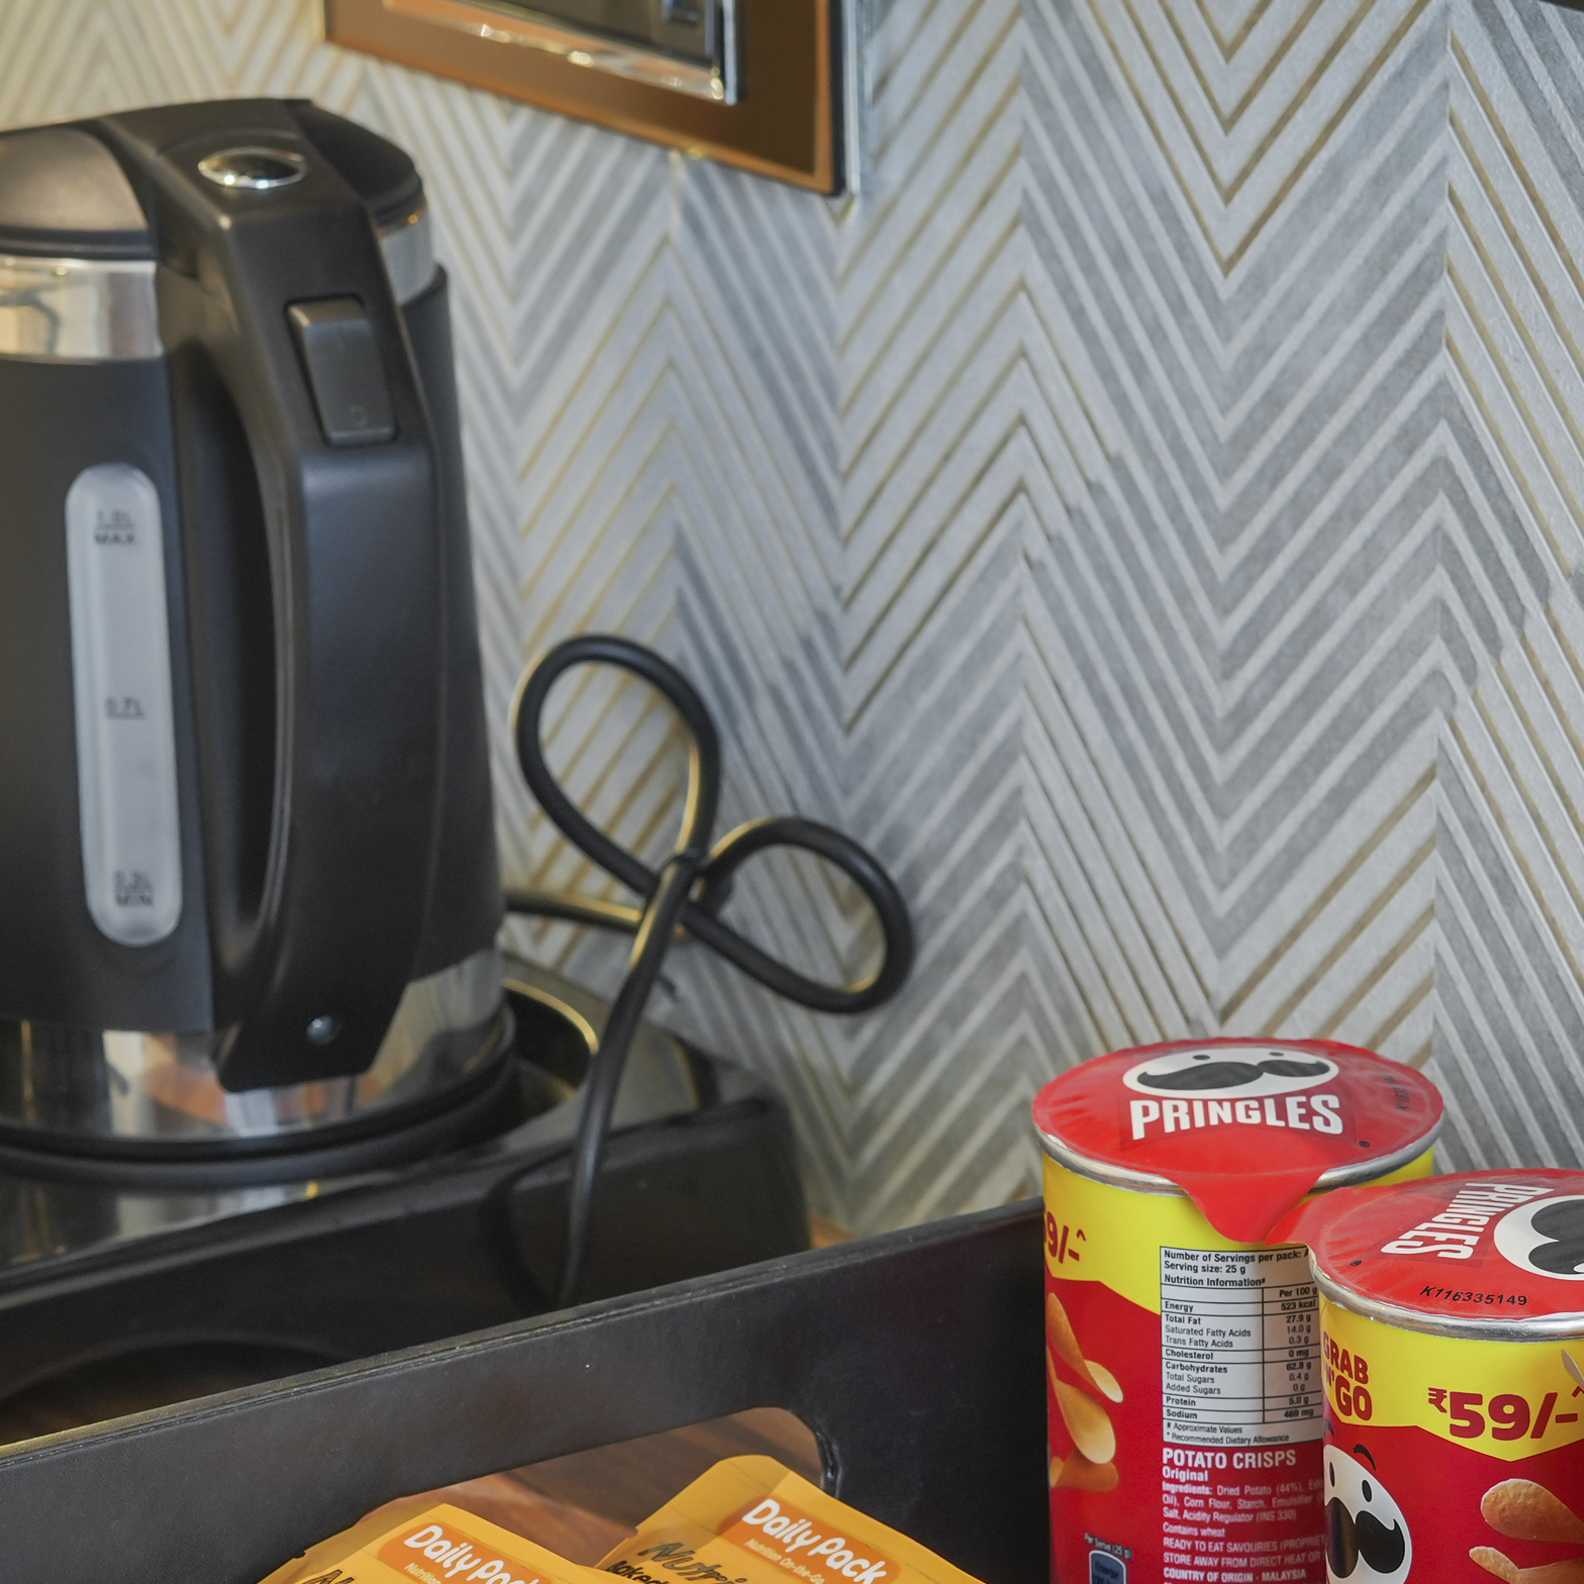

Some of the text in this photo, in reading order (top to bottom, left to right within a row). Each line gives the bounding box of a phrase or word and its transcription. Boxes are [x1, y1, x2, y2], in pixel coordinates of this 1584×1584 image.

[1129, 1094, 1344, 1140] PRINGLES
[1380, 1182, 1554, 1260] PRINGLES
[1164, 1250, 1199, 1262] Number
[1202, 1253, 1212, 1262] of
[1213, 1253, 1256, 1264] Servings
[1258, 1253, 1273, 1264] per
[1276, 1251, 1302, 1263] pack:
[1164, 1261, 1246, 1275] Serving size: 25 g
[1164, 1274, 1204, 1286] Nutrition
[1279, 1287, 1310, 1298] Per 100
[1421, 1286, 1528, 1307] K116335149
[1165, 1299, 1316, 1312] Energy 523 kcal
[1165, 1314, 1185, 1324] Total
[1187, 1316, 1201, 1325] Fat
[1165, 1325, 1304, 1337] Saturated Fatty Acids 14.0
[1165, 1335, 1302, 1348] Trans Fatty Acids 0.3
[1165, 1349, 1309, 1360] Cholesterol mg
[1323, 1330, 1369, 1385] GRAB
[1165, 1361, 1228, 1374] Carbohydrates
[1165, 1372, 1302, 1385] Total Sugars 0.4
[1165, 1383, 1221, 1396] Added Sugars
[1166, 1396, 1196, 1406] Protein
[1336, 1374, 1373, 1421] GO
[1166, 1408, 1314, 1419] Sodium mg
[1162, 1447, 1297, 1470] POTATO CRISPS
[1162, 1465, 1209, 1483] Original
[742, 1498, 821, 1553] Daily
[403, 1524, 482, 1578] Daily
[1163, 1536, 1193, 1551] READY
[1194, 1540, 1206, 1552] TO
[1208, 1540, 1225, 1553] EAT
[1163, 1551, 1192, 1566] STORE
[1193, 1555, 1219, 1567] AWAY
[1163, 1567, 1307, 1583] COUNTRY OF ORIGIN MALAYSIA
